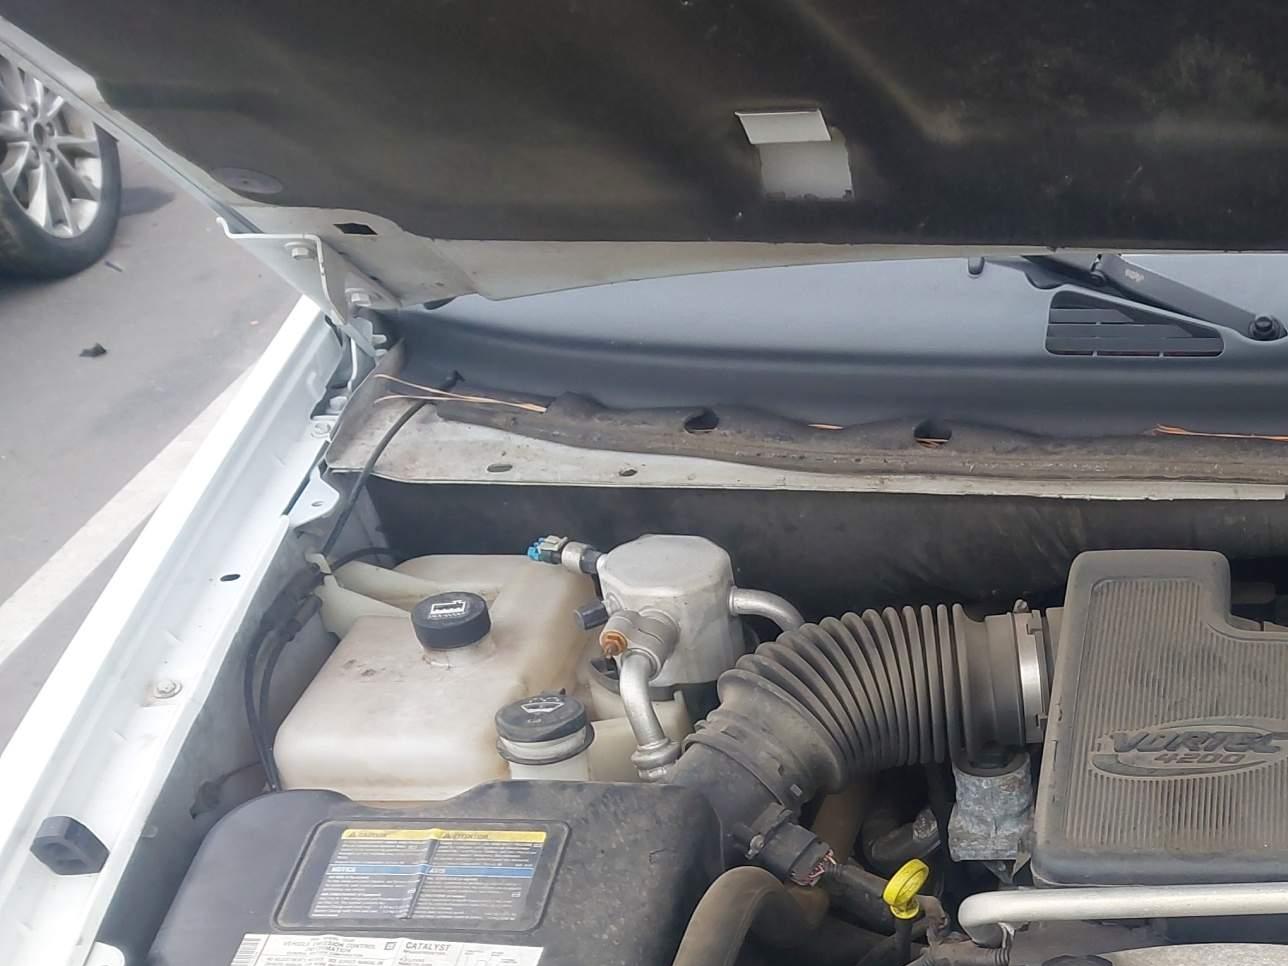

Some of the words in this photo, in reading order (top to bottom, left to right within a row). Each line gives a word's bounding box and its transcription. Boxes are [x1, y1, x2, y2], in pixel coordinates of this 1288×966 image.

[1110, 731, 1283, 753] VORTEC
[1154, 753, 1246, 764] 4200
[405, 941, 451, 951] CATALYST
